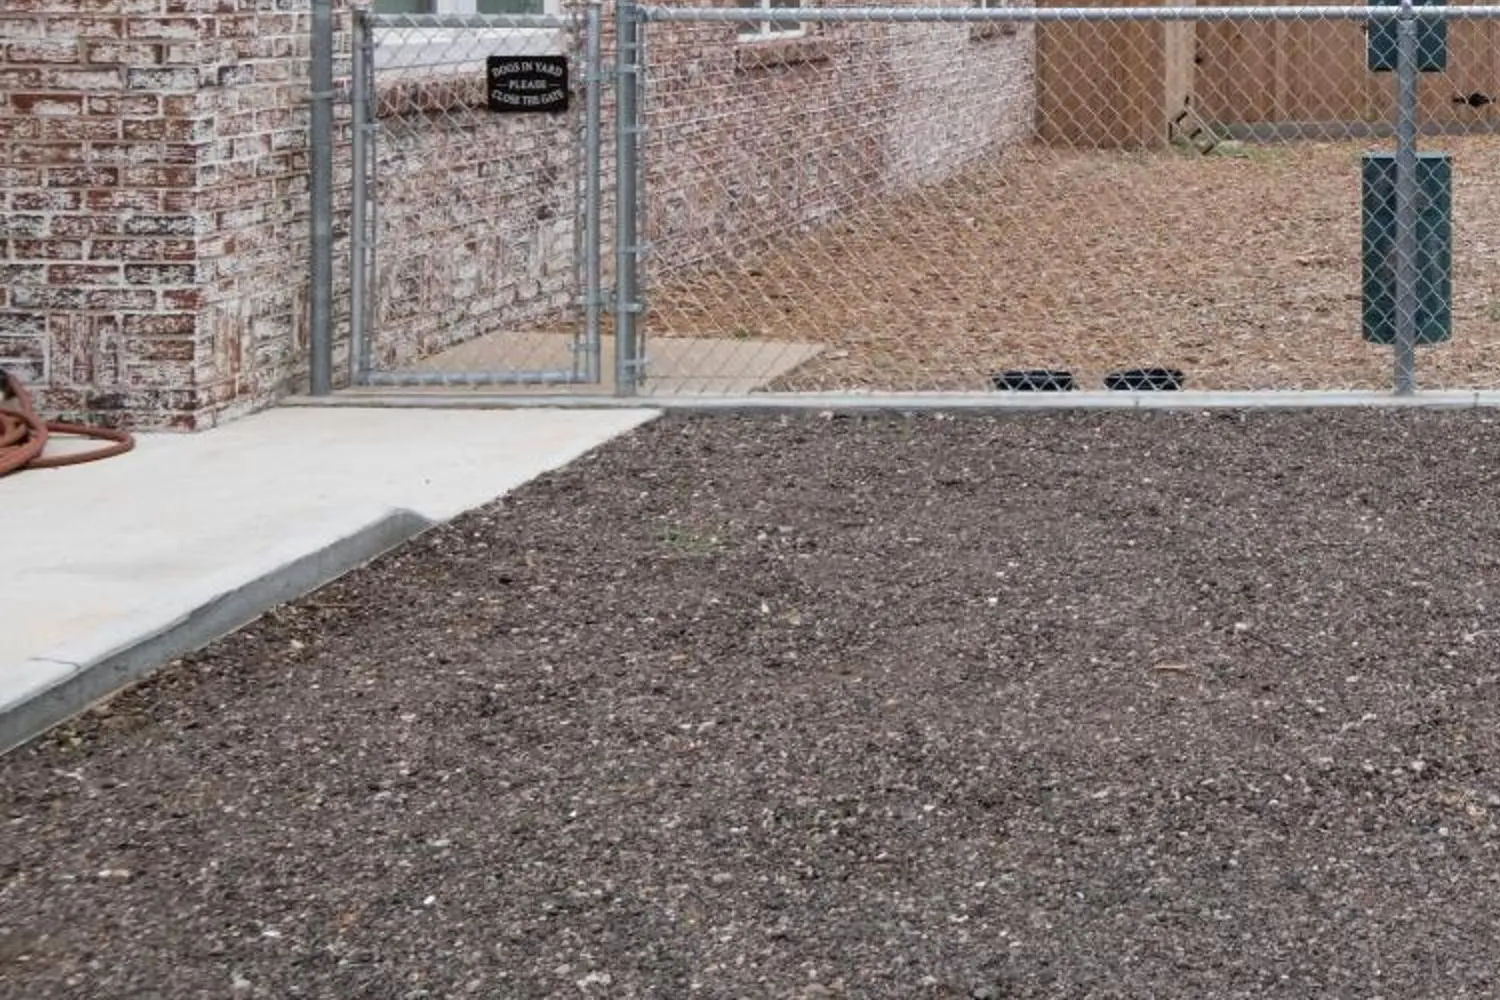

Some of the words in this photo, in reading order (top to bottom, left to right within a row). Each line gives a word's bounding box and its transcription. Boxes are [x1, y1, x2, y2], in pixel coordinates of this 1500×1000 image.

[491, 61, 520, 78] DOGS
[521, 61, 533, 72] IN
[535, 61, 563, 77] YARD
[509, 79, 547, 89] PLEASE
[491, 89, 521, 105] CLOSE
[522, 95, 540, 105] THE
[541, 89, 564, 104] GATE
